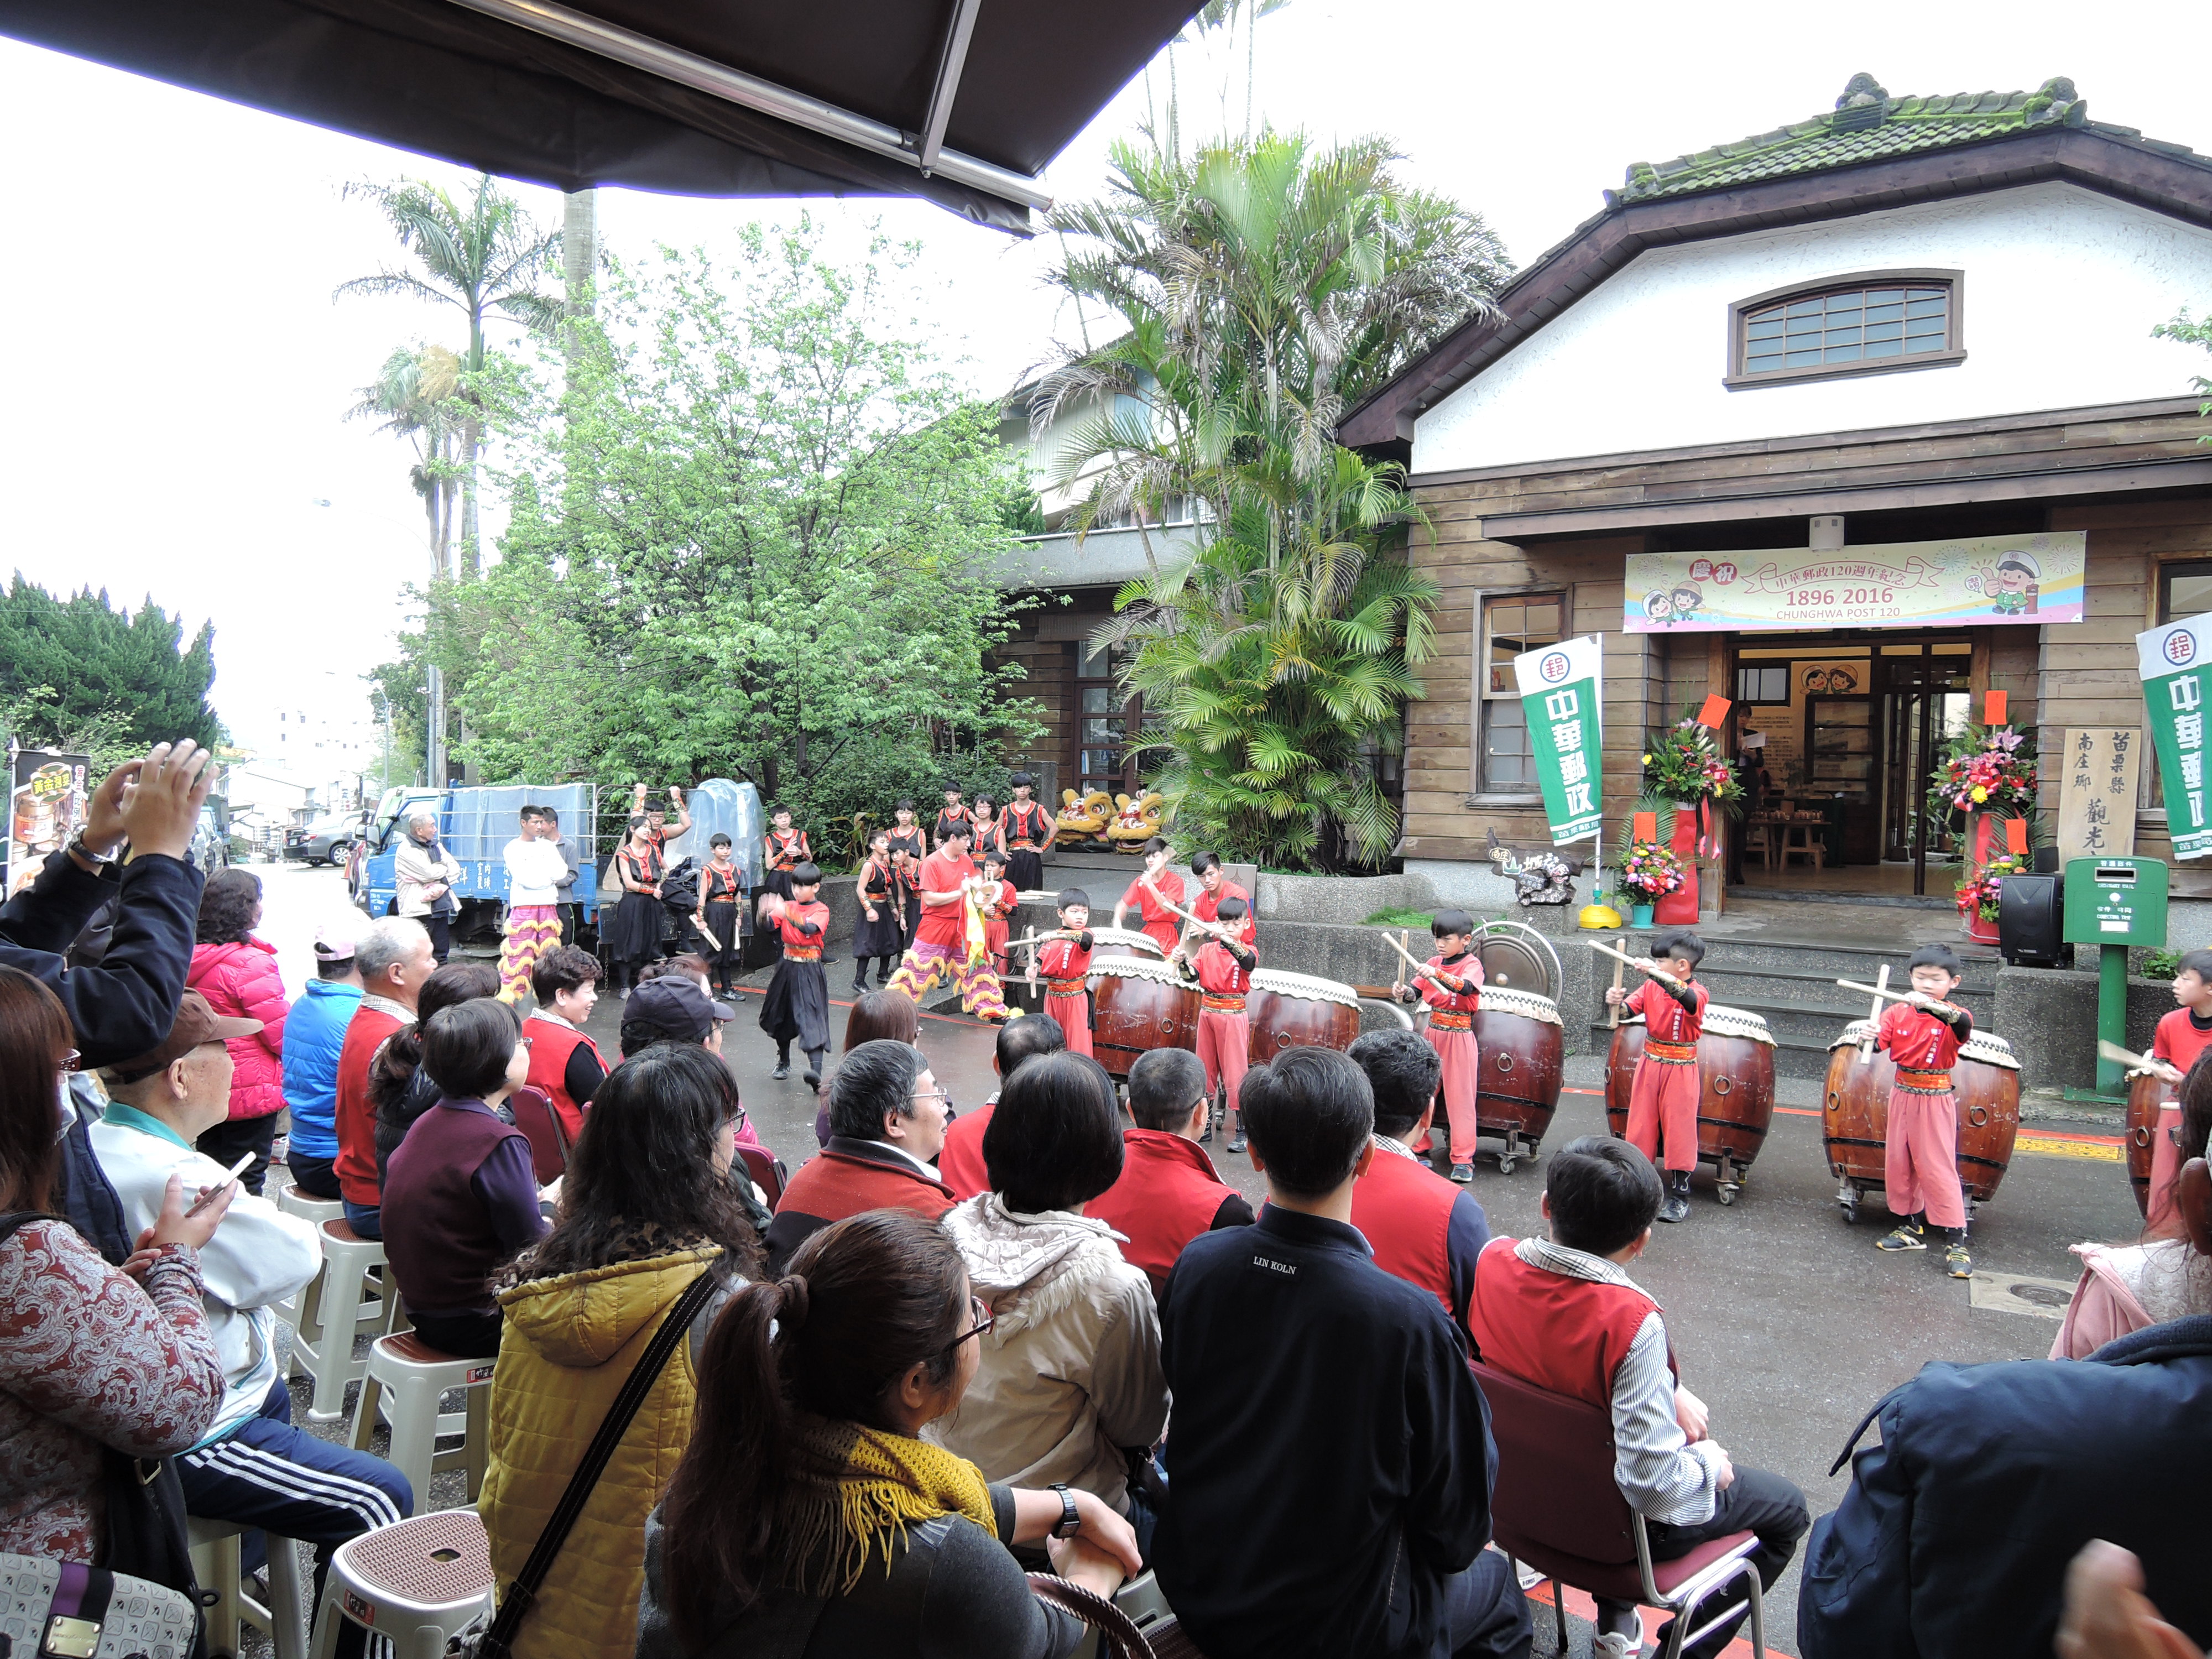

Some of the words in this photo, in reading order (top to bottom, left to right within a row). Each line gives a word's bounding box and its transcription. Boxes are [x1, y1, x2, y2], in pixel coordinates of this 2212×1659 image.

[1692, 561, 1734, 582] 慶祝
[1776, 565, 1907, 589] 中華郵政120週年紀念
[1776, 608, 1843, 619] CHUNGHWA
[1847, 608, 1876, 618] POST
[1880, 607, 1900, 617] 120
[1545, 690, 1594, 817] 中華郵政
[2073, 732, 2094, 792] 南庄鄉
[2107, 731, 2131, 794] 苗栗縣
[2082, 797, 2111, 855] 觀光
[1491, 849, 1509, 861] 南庄
[1253, 1256, 1270, 1267] LIN
[1270, 1261, 1297, 1275] KOLN
